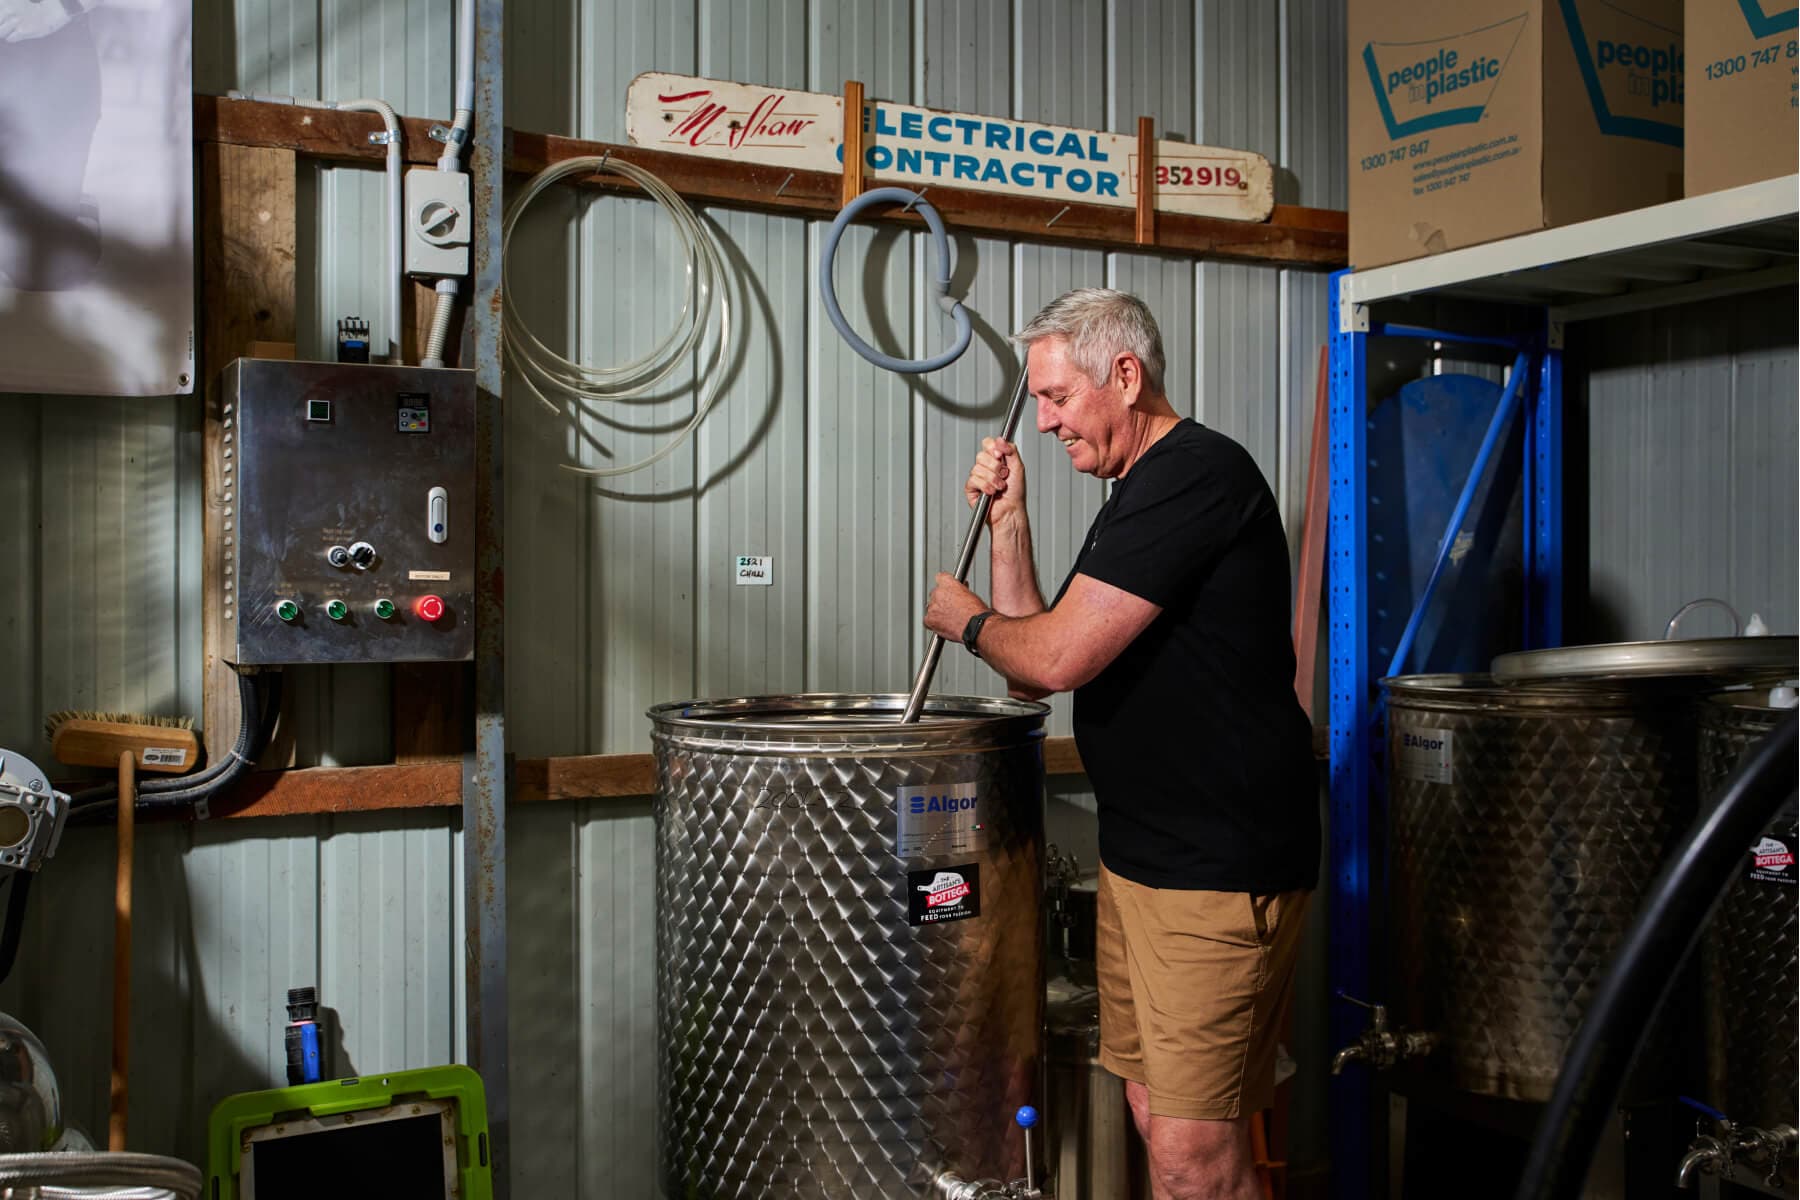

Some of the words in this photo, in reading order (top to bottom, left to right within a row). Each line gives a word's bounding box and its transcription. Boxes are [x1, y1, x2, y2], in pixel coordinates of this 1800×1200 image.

[1389, 48, 1458, 94] people
[1705, 55, 1746, 80] 1300
[1751, 45, 1781, 69] 747
[1425, 56, 1499, 104] plastic
[729, 94, 815, 150] Shaw
[863, 106, 1109, 163] LECTRICAL
[1361, 153, 1386, 171] 1300
[1388, 146, 1407, 164] 747
[1409, 139, 1430, 158] 847
[1411, 735, 1444, 751] Algor
[927, 795, 978, 813] Algor
[1755, 854, 1793, 866] BOTTEGA
[928, 906, 957, 914] EQUIPMENT
[929, 884, 969, 905] BOTTEGA
